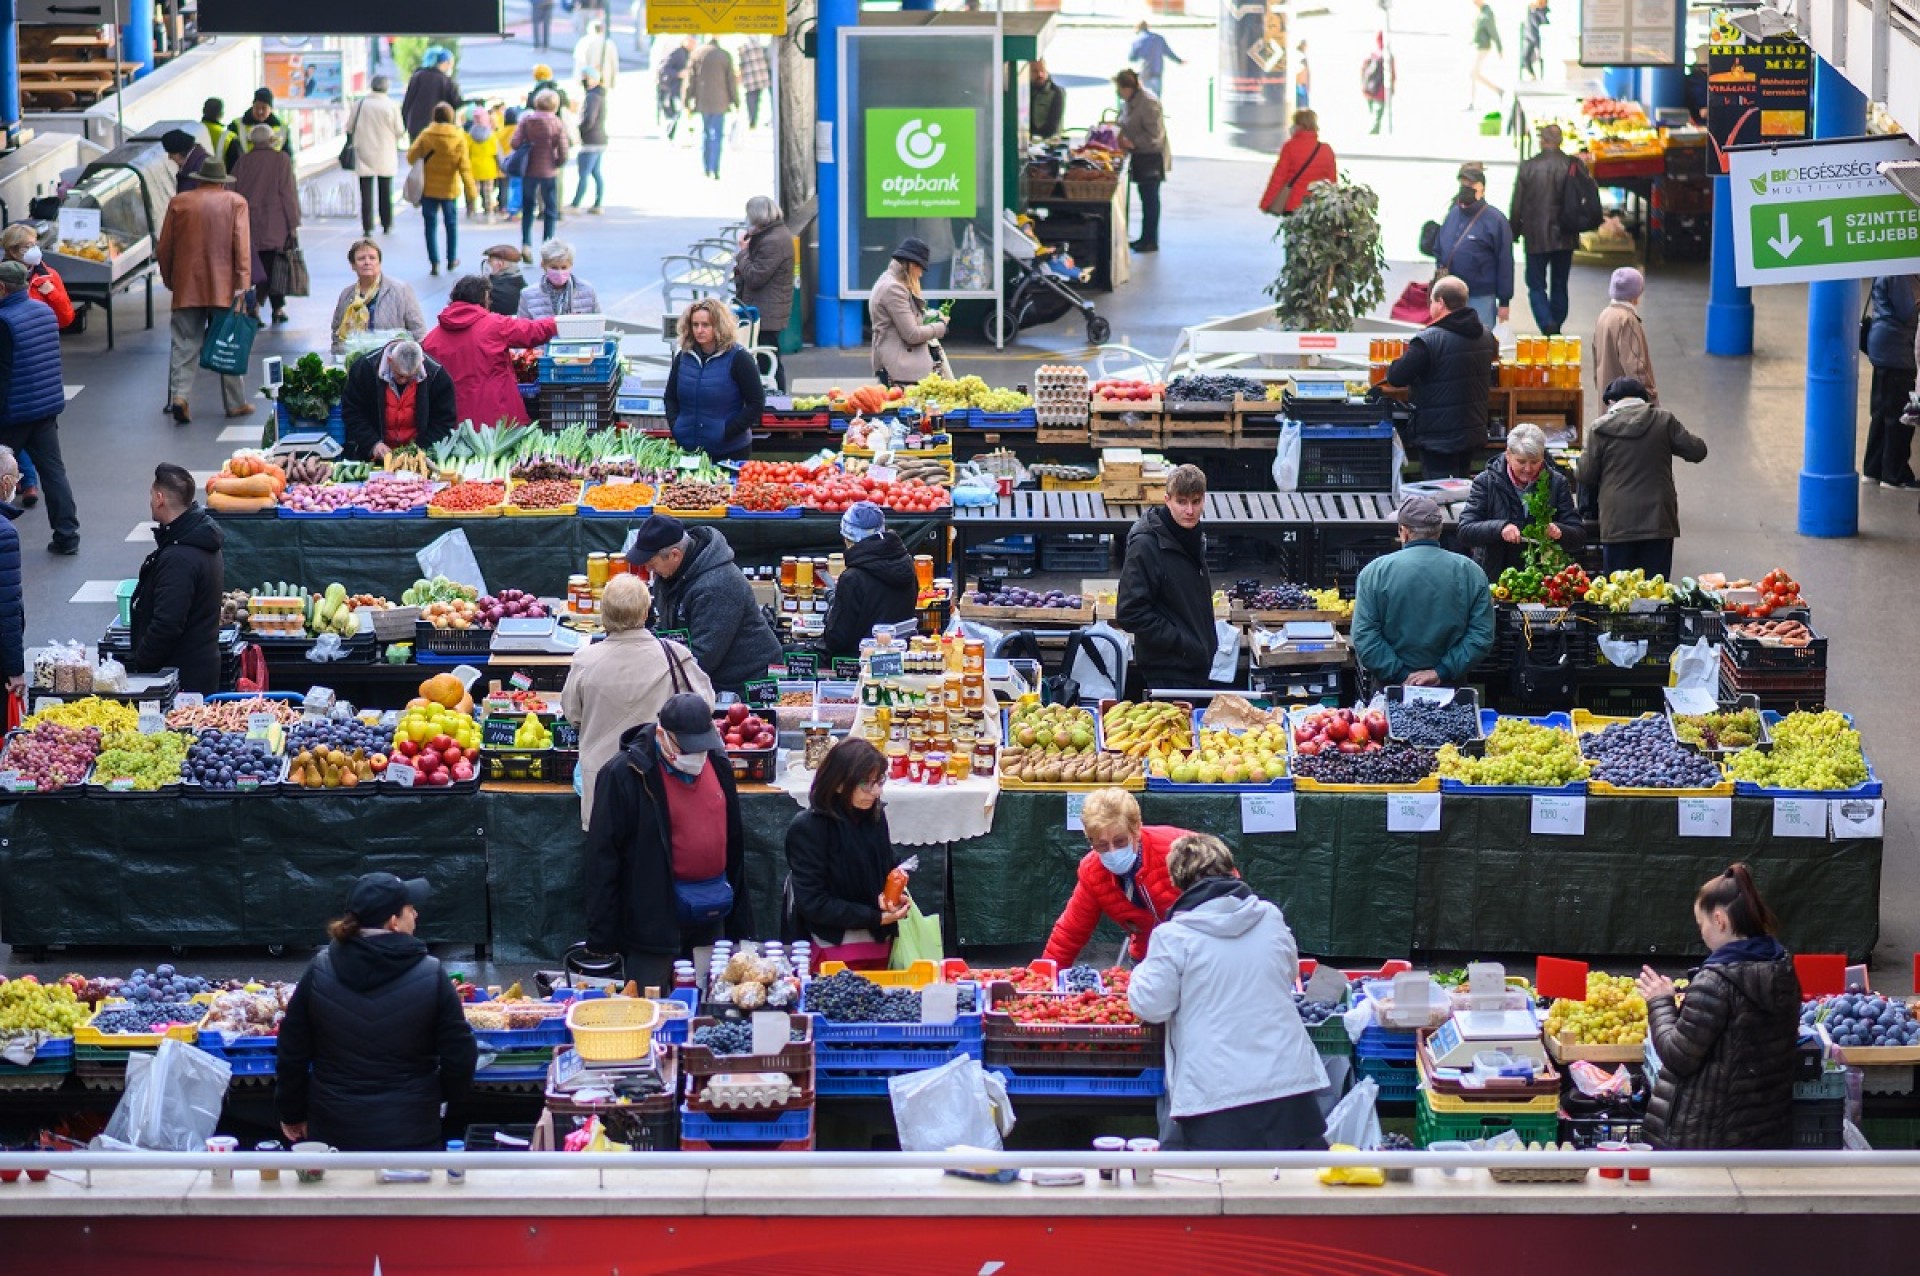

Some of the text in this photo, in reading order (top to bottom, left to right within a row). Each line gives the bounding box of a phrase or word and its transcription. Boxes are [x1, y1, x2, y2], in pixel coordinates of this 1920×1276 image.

[1709, 44, 1807, 55] TERMELŐI
[1764, 57, 1807, 70] MÉZ
[1770, 159, 1871, 183] BIOEGÉSZSÉG
[882, 172, 960, 197] otpbank
[1817, 215, 1834, 247] 1
[1846, 226, 1919, 246] LEJJEBB
[1283, 530, 1297, 542] 21
